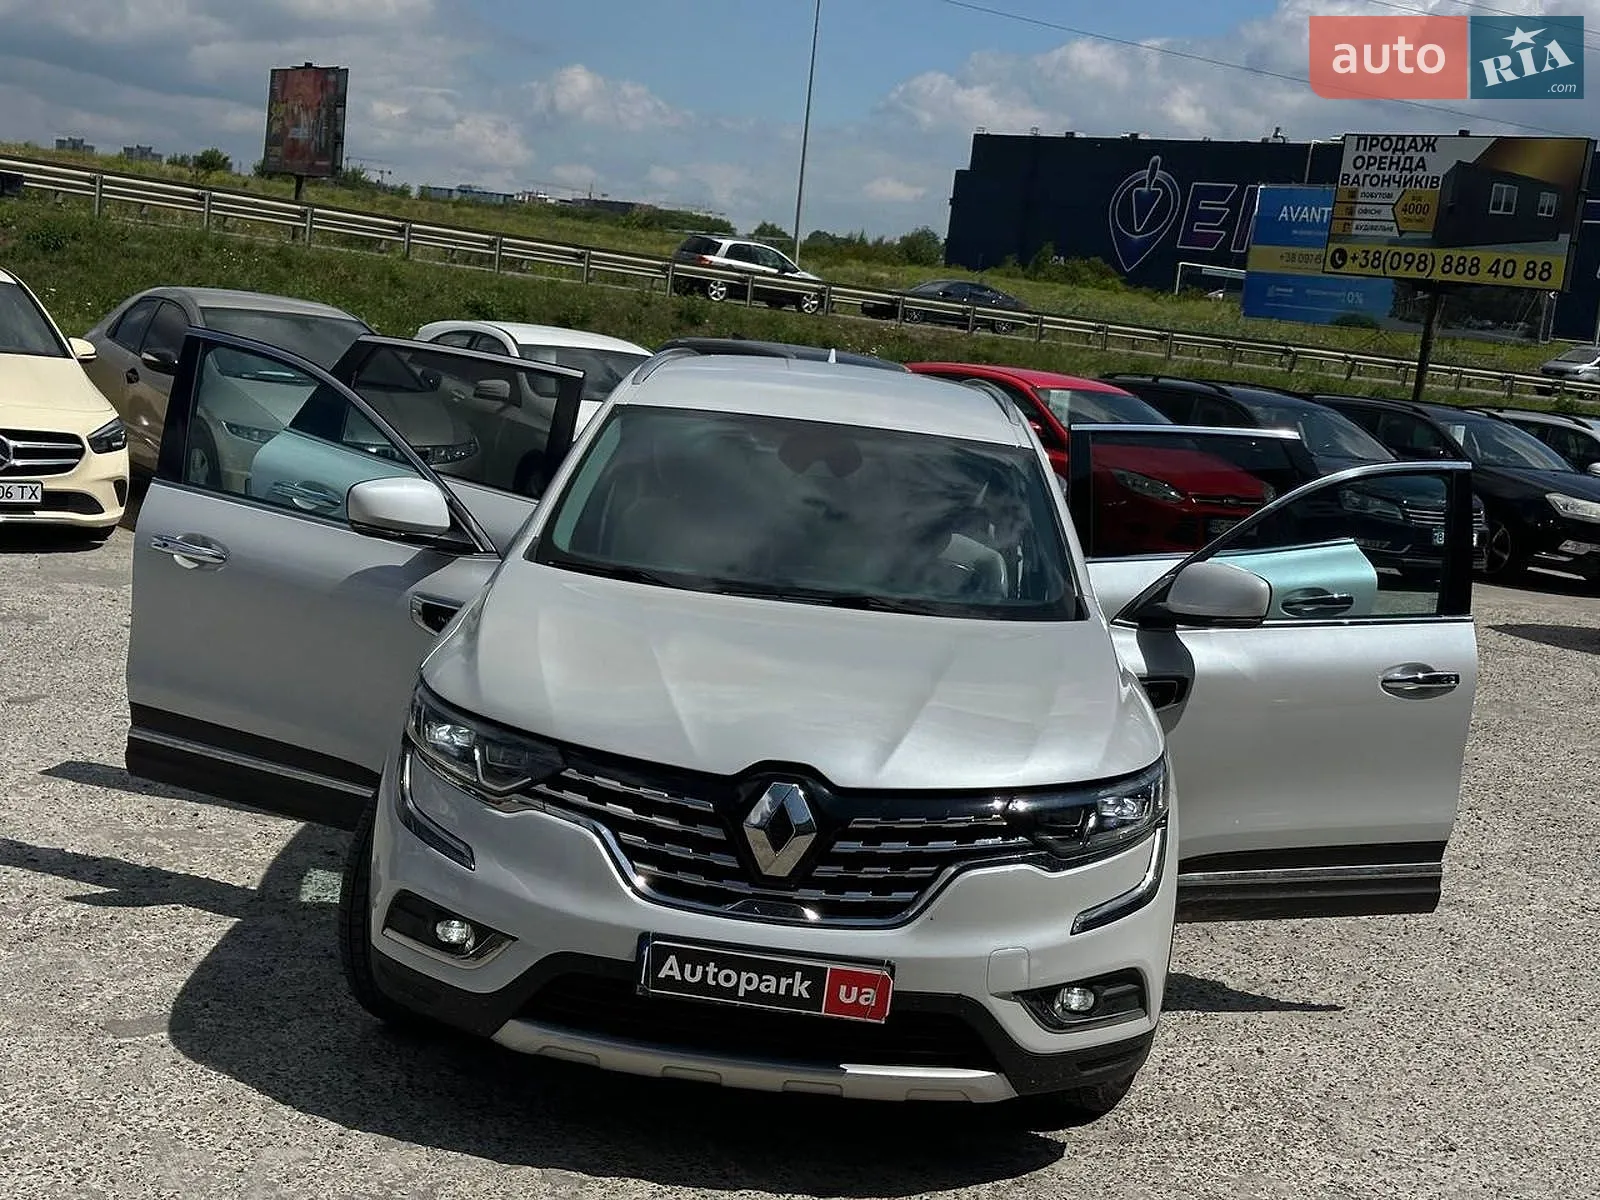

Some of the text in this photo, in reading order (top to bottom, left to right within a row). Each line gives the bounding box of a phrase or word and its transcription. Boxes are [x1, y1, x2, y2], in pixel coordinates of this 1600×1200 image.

[1355, 135, 1438, 155] ПРОДАЖ
[1352, 155, 1427, 174] ОРЕНДА
[1340, 173, 1441, 189] ВАГОНЧИКІВ
[1401, 203, 1430, 216] 4000
[1350, 249, 1553, 282] +38(098) 888 40 88
[17, 486, 39, 500] TX
[657, 953, 876, 1007] Autopark ua
